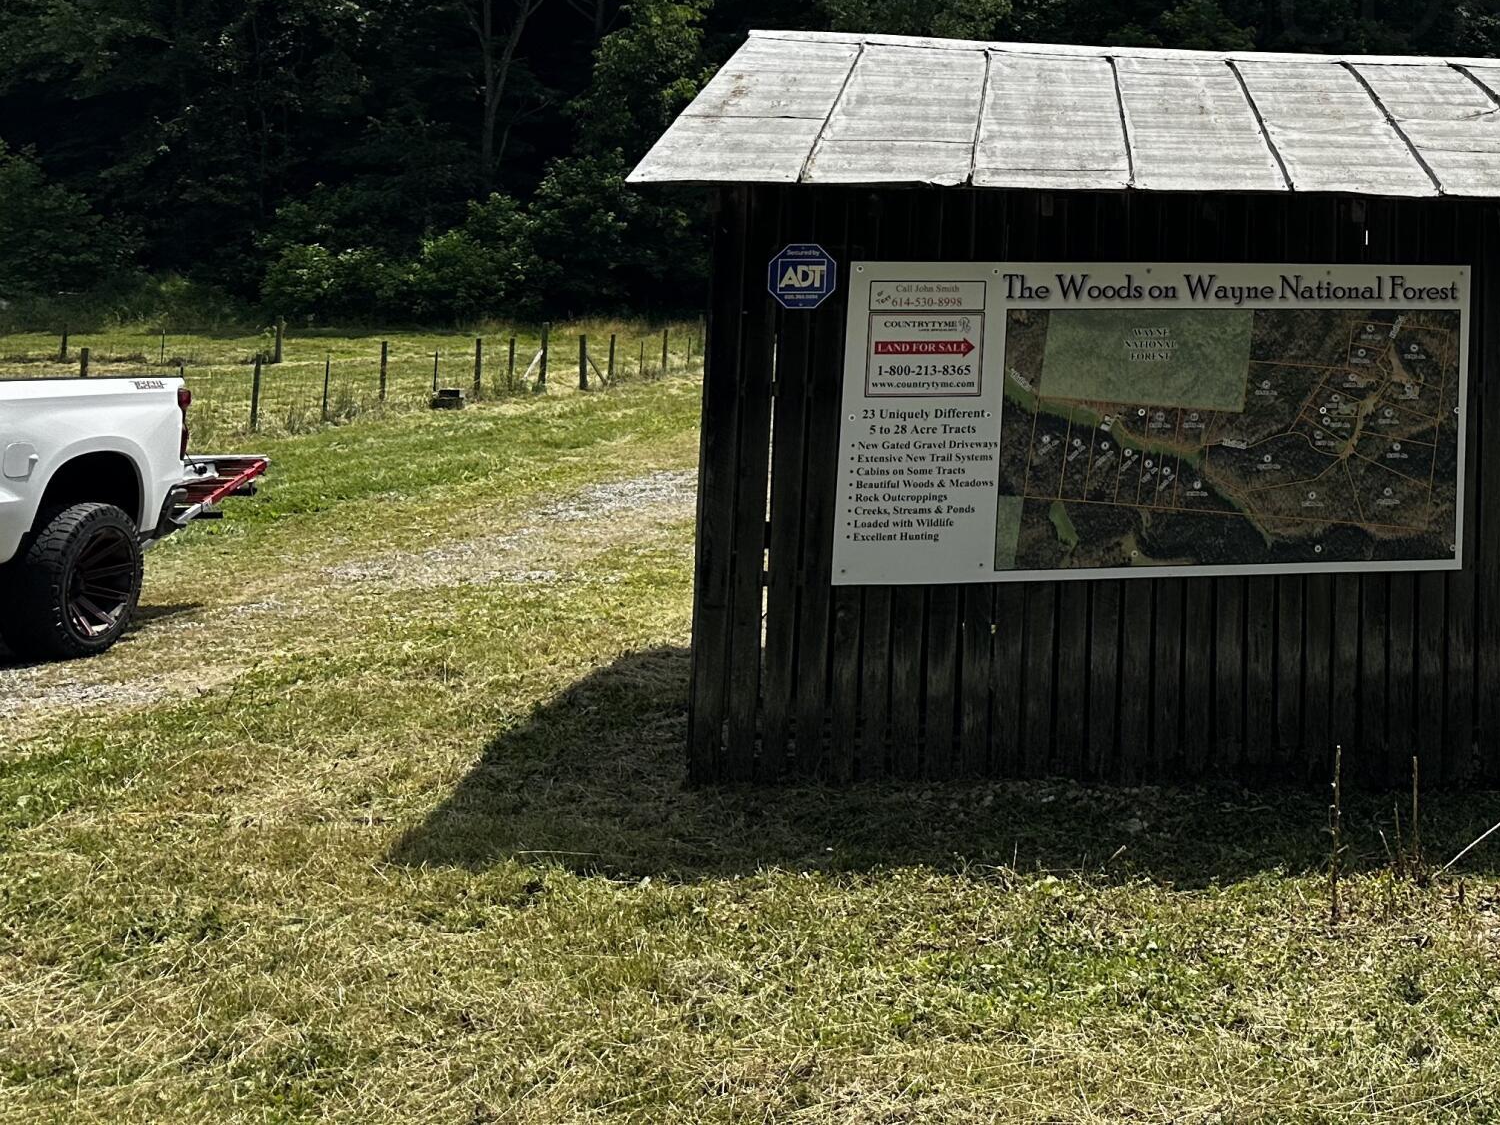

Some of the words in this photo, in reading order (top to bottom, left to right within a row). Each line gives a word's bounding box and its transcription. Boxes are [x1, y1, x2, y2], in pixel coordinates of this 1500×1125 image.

[779, 265, 826, 288] ADT
[896, 284, 913, 293] Call
[914, 284, 934, 293] John
[935, 284, 960, 293] Smith
[1003, 274, 1050, 299] The
[1055, 274, 1143, 300] Woods
[1148, 285, 1176, 299] on
[1183, 274, 1274, 305] Wayne
[1280, 275, 1382, 300] National
[1389, 276, 1457, 300] Forest
[892, 297, 962, 307] 614-530-8998
[884, 320, 957, 328] COUNTRYTYME
[878, 343, 910, 352] LAND
[912, 343, 936, 352] FOR
[938, 343, 968, 352] SALE
[878, 365, 971, 376] 1-800-213-8365
[872, 380, 975, 390] www.countrytyme.com
[862, 409, 875, 419] 23
[880, 409, 930, 421] Uniquely
[934, 408, 985, 419] Different
[869, 425, 876, 434] 5
[879, 425, 891, 434] to
[894, 424, 907, 434] 28
[910, 424, 938, 434] Acre
[941, 424, 976, 434] Tracts
[858, 441, 879, 449] New
[881, 441, 911, 450] Gated
[913, 440, 946, 449] Gravel
[949, 440, 998, 450] Driveways
[857, 454, 903, 463] Extensive
[905, 454, 926, 462] New
[929, 453, 953, 462] Trail
[955, 453, 993, 463] Systems
[856, 467, 890, 476] Cabins
[906, 467, 933, 475] Some
[935, 466, 966, 475] Tracts
[856, 480, 900, 489] Beautiful
[902, 480, 935, 488] Woods
[937, 479, 946, 488] &
[949, 479, 994, 488] Meadows
[855, 493, 879, 502] Rock
[882, 493, 948, 503] Outcroppings
[854, 506, 890, 516] Creeks,
[892, 506, 932, 515] Streams
[934, 505, 943, 514] &
[946, 505, 976, 514] Ponds
[853, 519, 889, 528] Loaded
[892, 519, 913, 528] with
[916, 518, 954, 527] Wildlife
[852, 532, 897, 541] Excellent
[899, 532, 939, 542] Hunting
